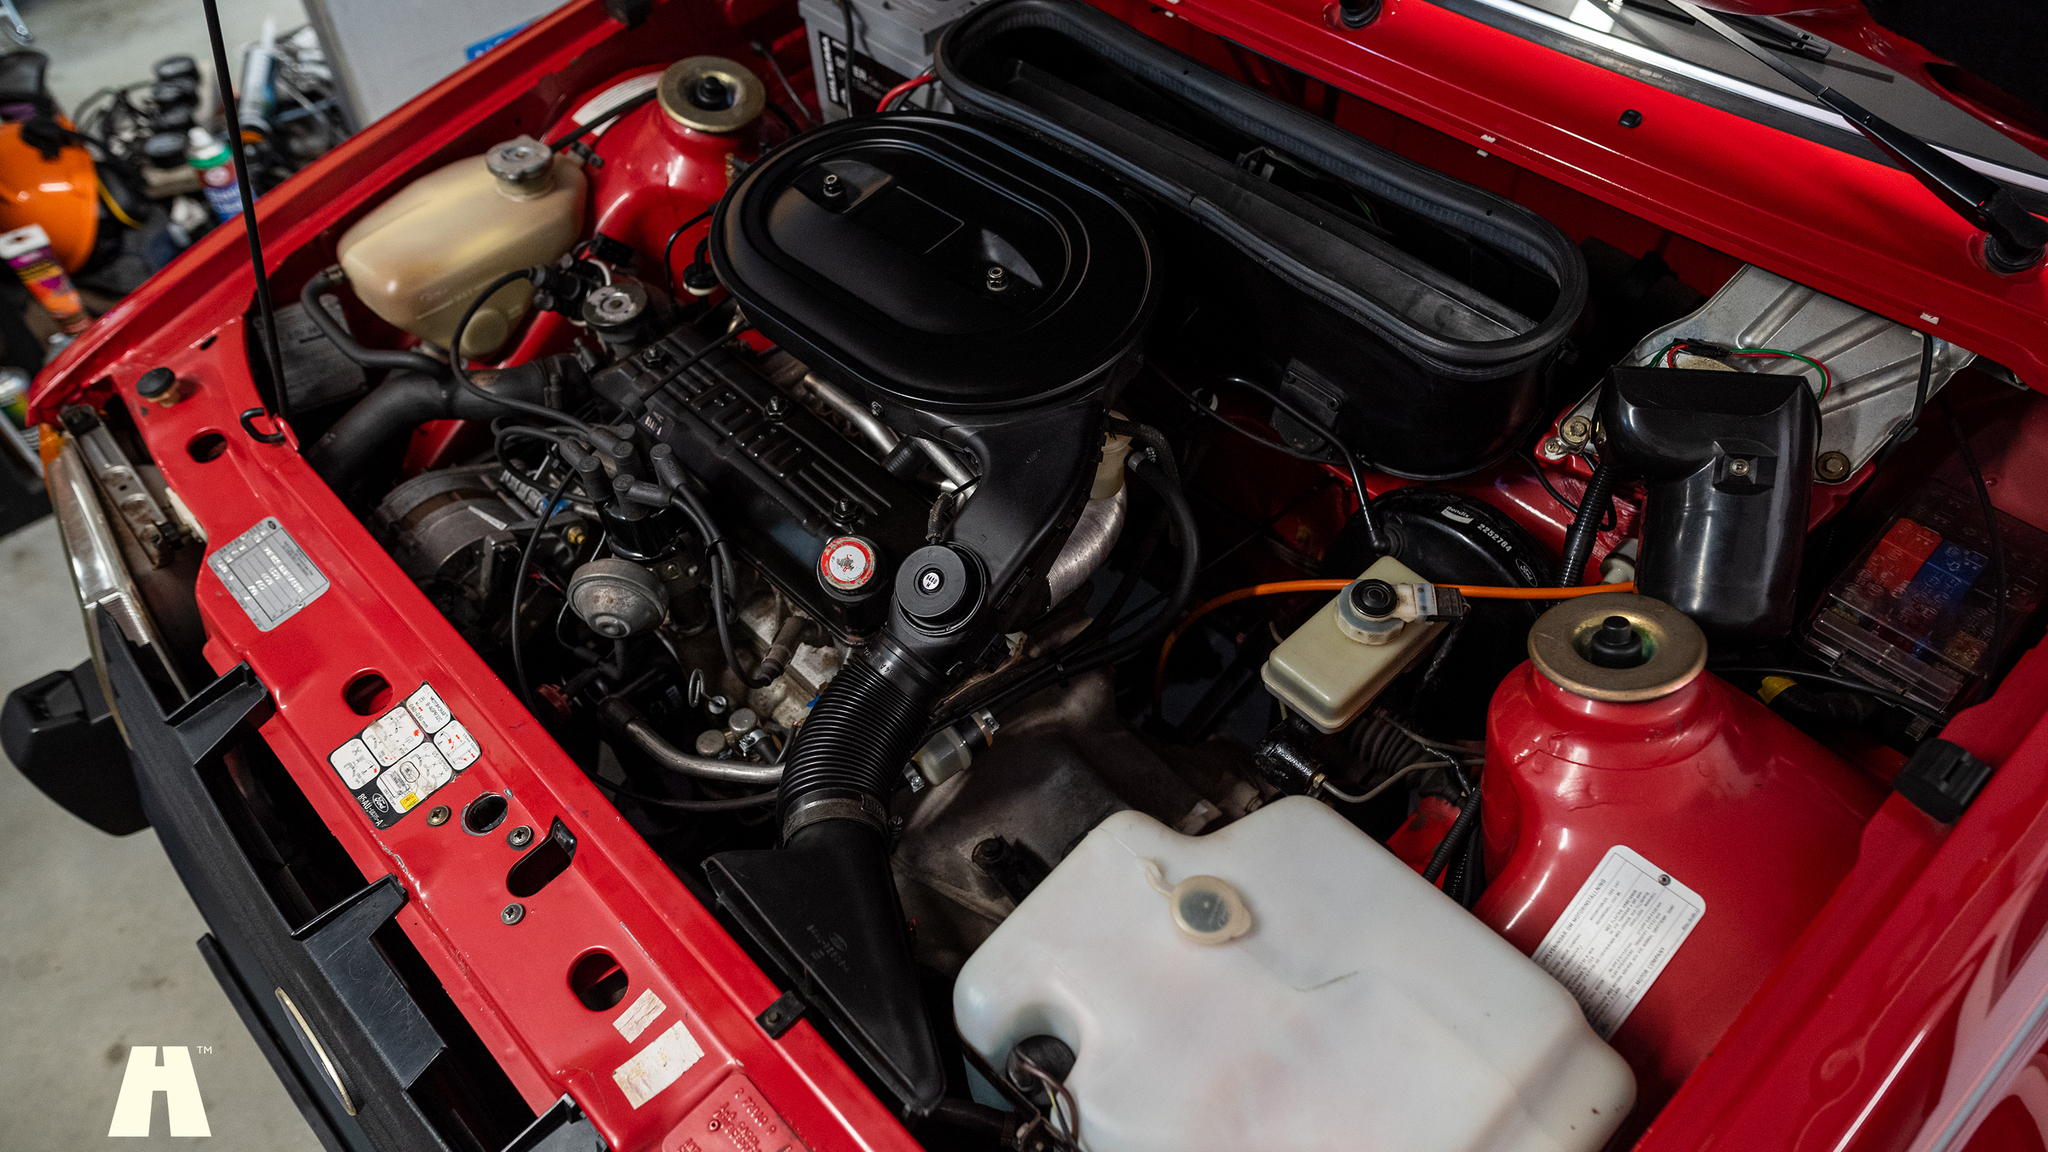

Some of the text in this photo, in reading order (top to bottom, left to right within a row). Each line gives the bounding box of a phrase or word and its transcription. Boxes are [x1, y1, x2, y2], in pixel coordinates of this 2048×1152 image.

[1520, 564, 1533, 581] Ford
[374, 795, 387, 810] Ford
[1564, 921, 1574, 931] OM
[1646, 945, 1666, 970] COMPANY
